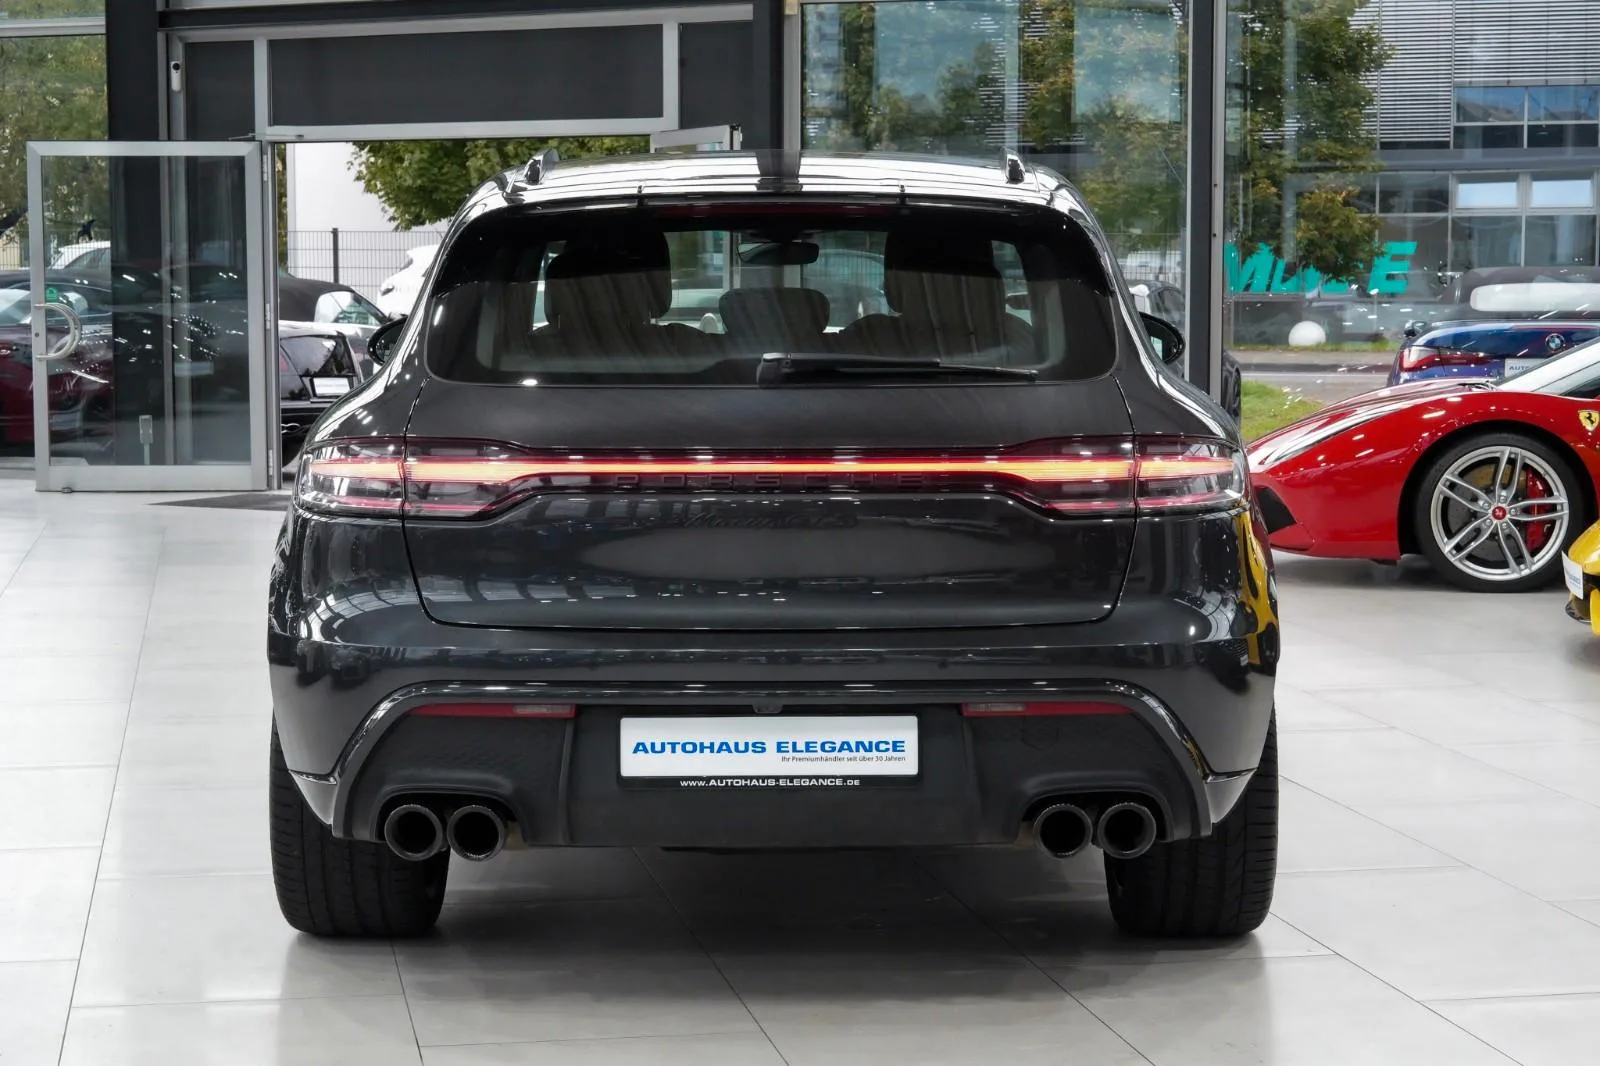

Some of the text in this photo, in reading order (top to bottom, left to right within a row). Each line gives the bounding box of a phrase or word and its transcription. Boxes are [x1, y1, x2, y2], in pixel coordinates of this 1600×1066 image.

[614, 473, 923, 488] PORSCHE
[632, 740, 906, 754] AUTOHAUS ELEGANCE
[781, 755, 791, 763] Ihr
[791, 755, 845, 763] Premiumhändler
[858, 754, 874, 762] über
[884, 755, 906, 763] Jahren
